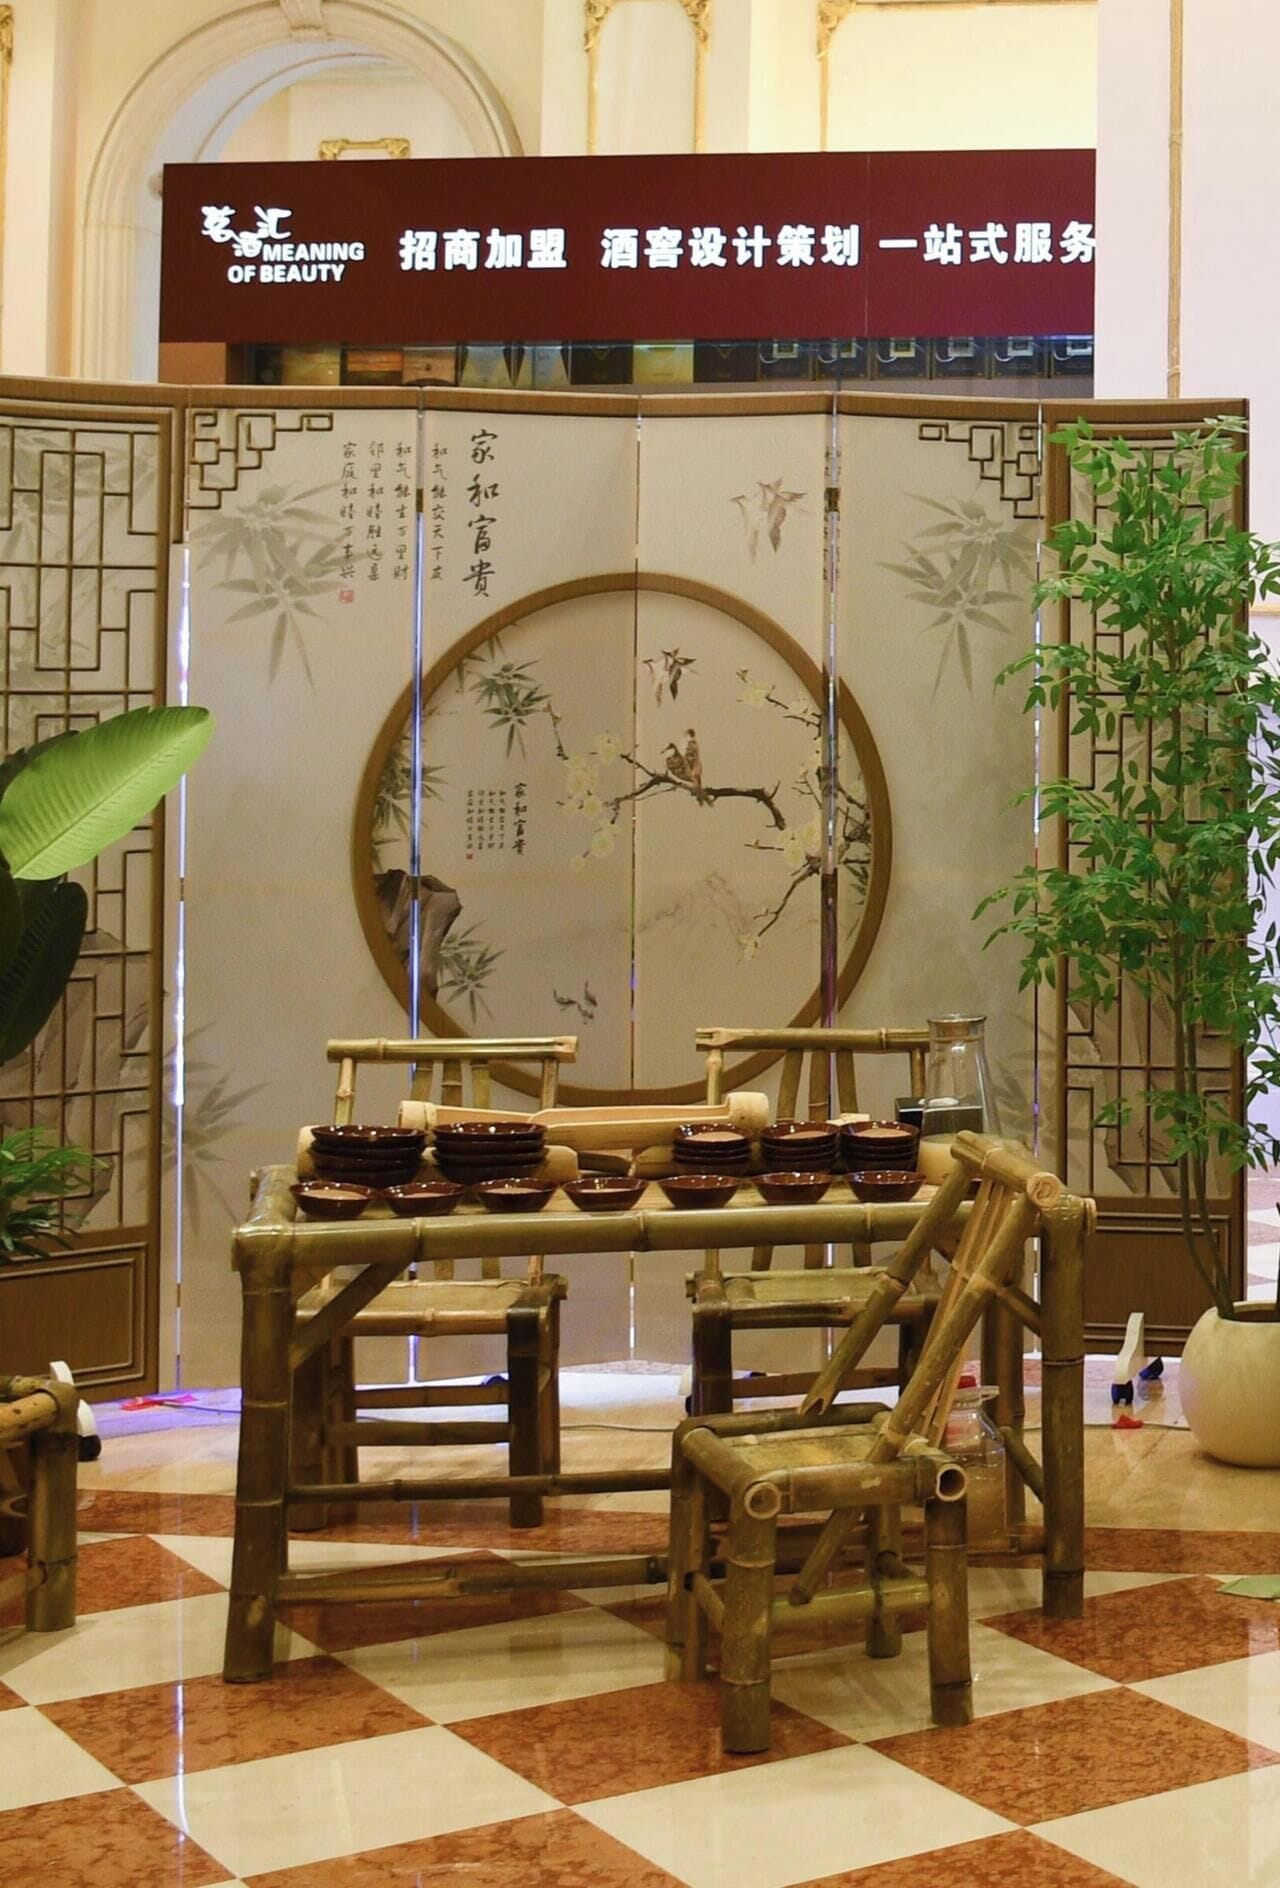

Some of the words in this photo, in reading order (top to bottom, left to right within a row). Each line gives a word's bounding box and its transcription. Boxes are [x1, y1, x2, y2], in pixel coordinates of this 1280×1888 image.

[262, 241, 365, 262] MEANING
[399, 227, 568, 271] 招商加盟
[600, 224, 861, 269] 酒窖设计策划
[878, 221, 1096, 265] 一站式服务
[226, 264, 256, 284] OF
[259, 263, 346, 283] BEAUTY
